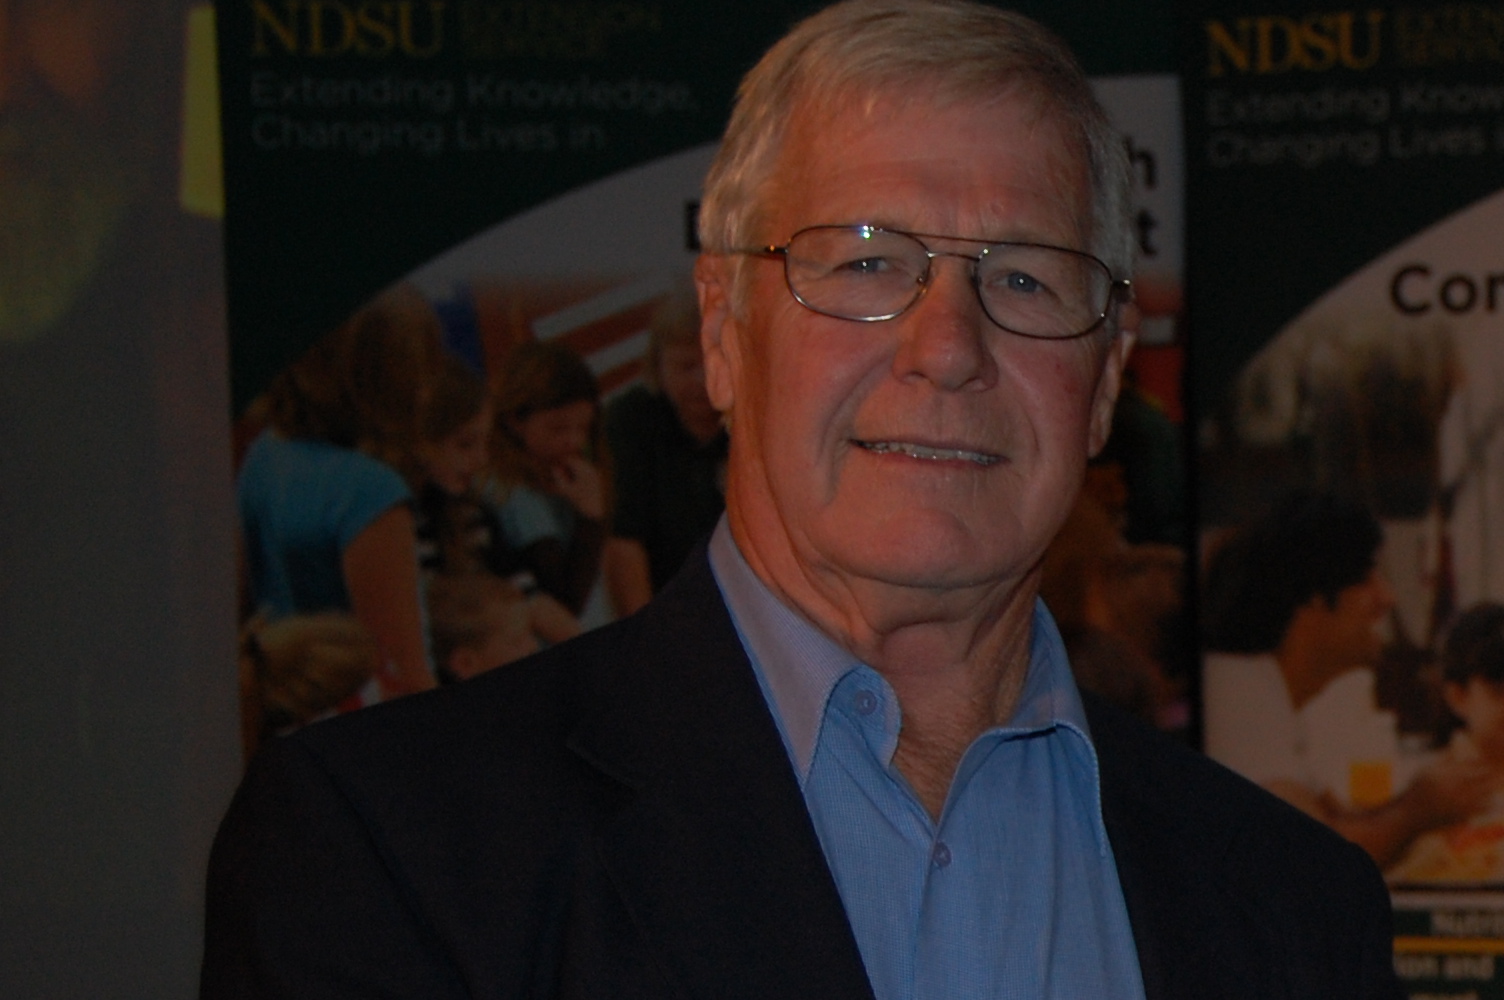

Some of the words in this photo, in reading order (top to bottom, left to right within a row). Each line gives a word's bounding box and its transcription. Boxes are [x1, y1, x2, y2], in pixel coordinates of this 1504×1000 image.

[250, 0, 446, 58] NDSU
[1202, 9, 1384, 77] NDSU
[250, 71, 454, 113] Extending
[1205, 84, 1391, 126] Extending
[250, 114, 444, 155] Changing
[456, 118, 558, 151] Lives
[569, 119, 607, 150] in
[1206, 127, 1382, 168] Changing
[1389, 124, 1485, 158] Lives
